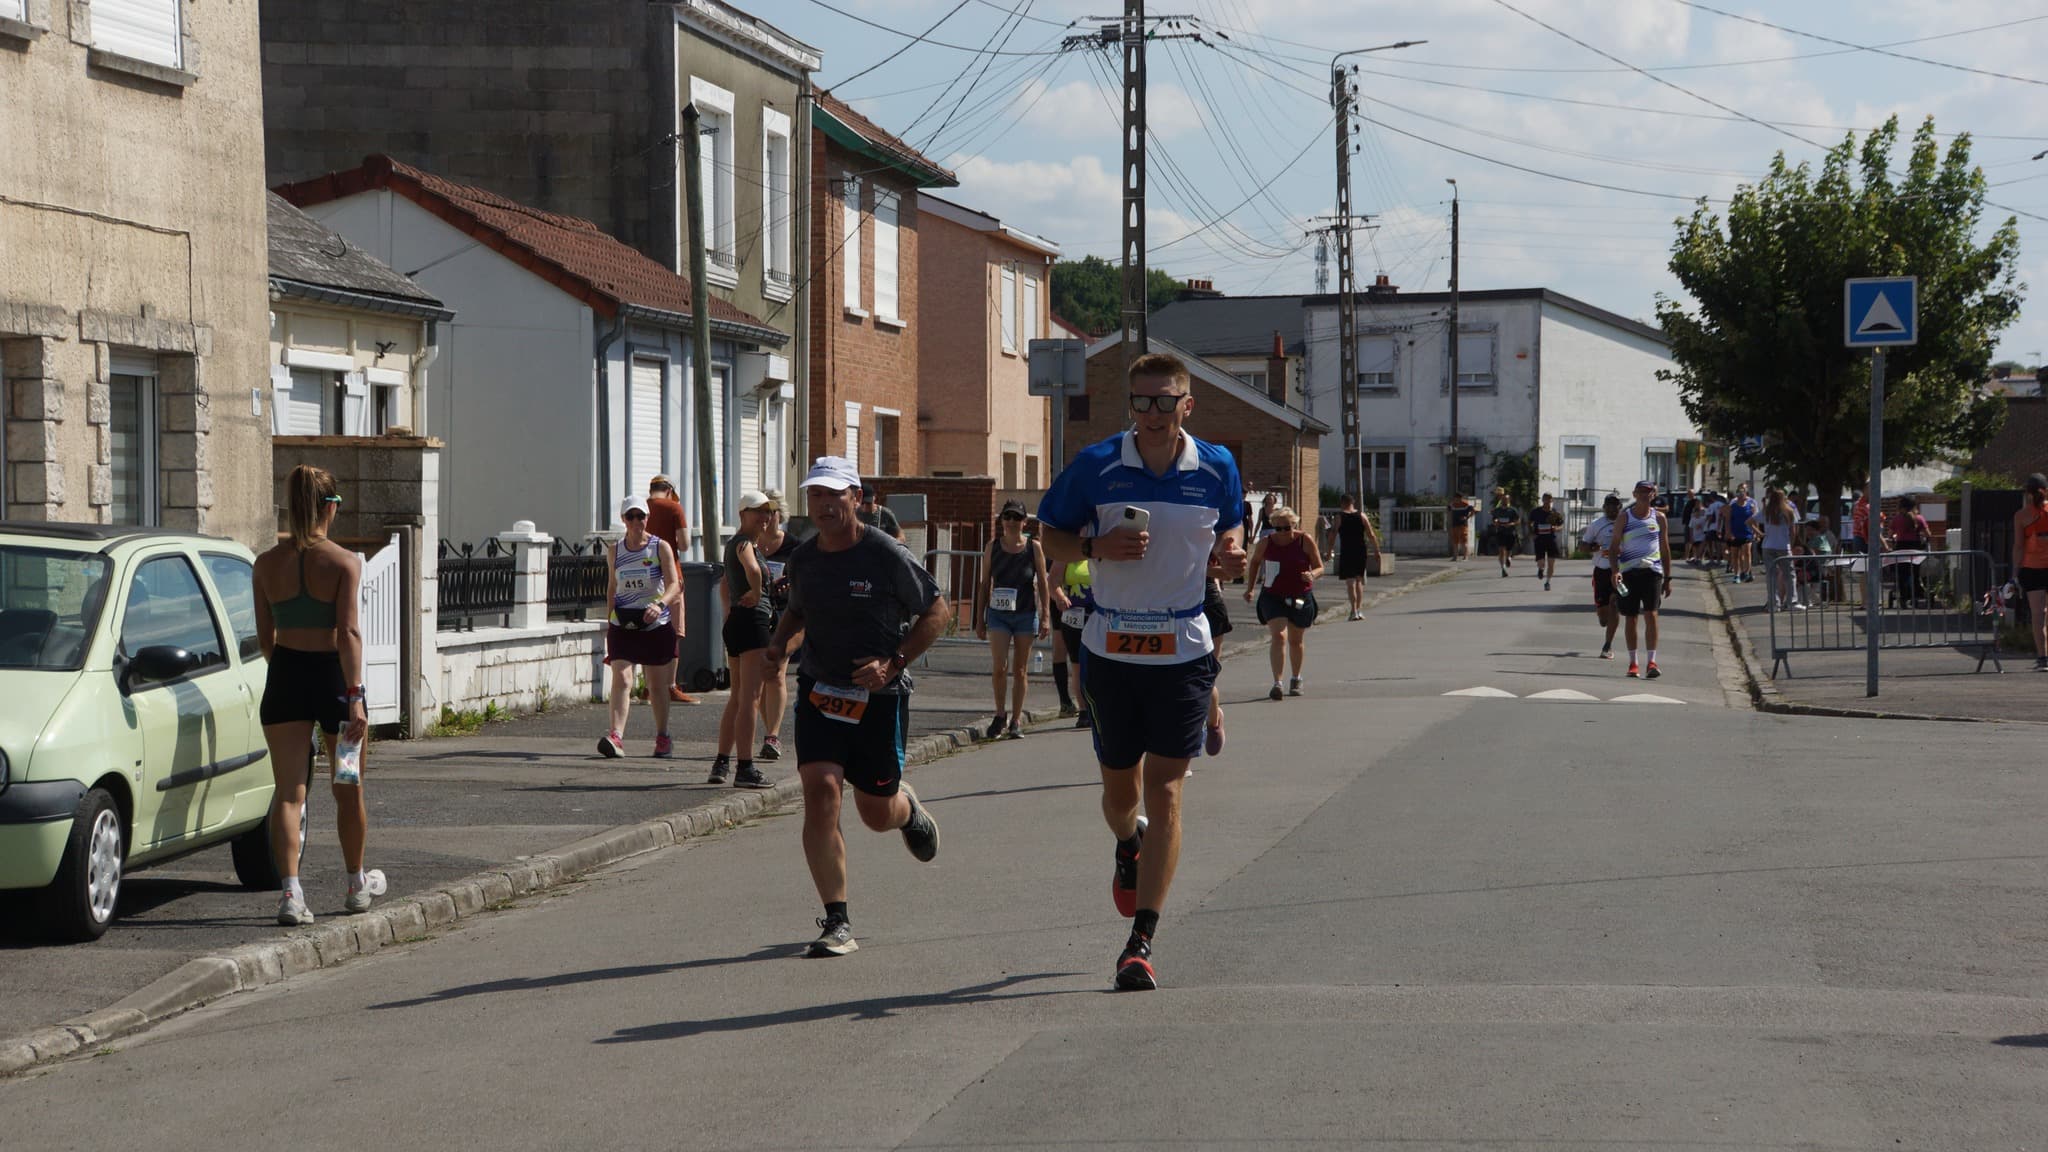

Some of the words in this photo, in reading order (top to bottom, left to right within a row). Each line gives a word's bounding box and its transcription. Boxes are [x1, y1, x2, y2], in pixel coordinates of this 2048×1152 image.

[625, 579, 644, 588] 415
[1118, 633, 1163, 653] 279
[818, 695, 858, 717] 297
